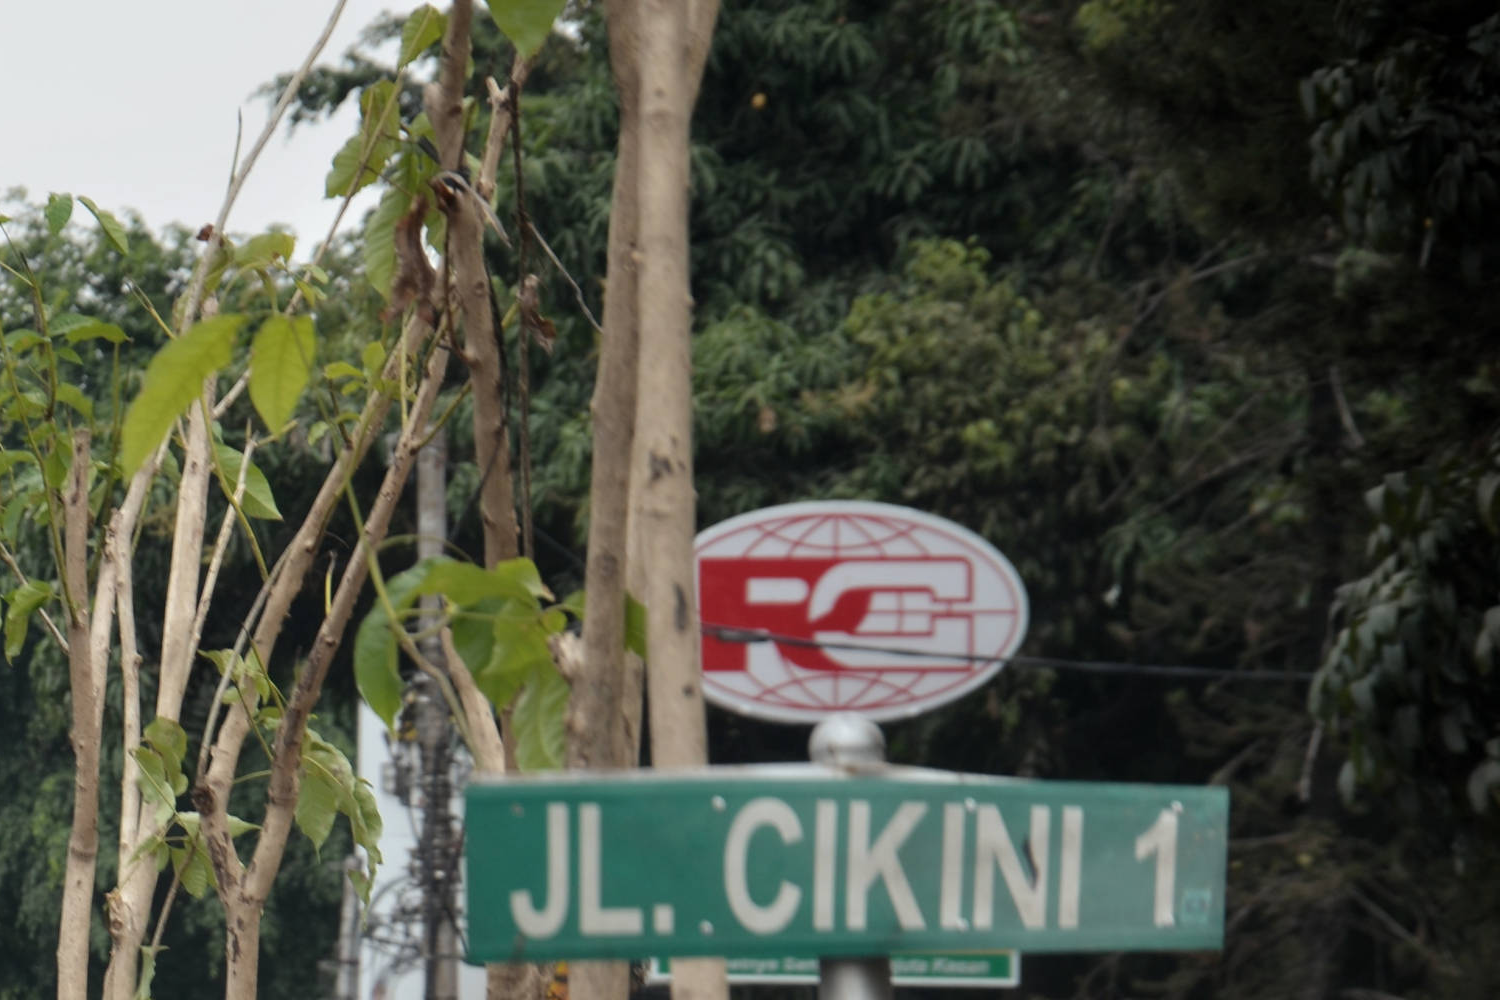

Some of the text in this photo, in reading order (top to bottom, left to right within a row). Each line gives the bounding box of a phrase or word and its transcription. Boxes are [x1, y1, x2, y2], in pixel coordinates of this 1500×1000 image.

[510, 797, 1181, 936] JL. CIKINI 1
